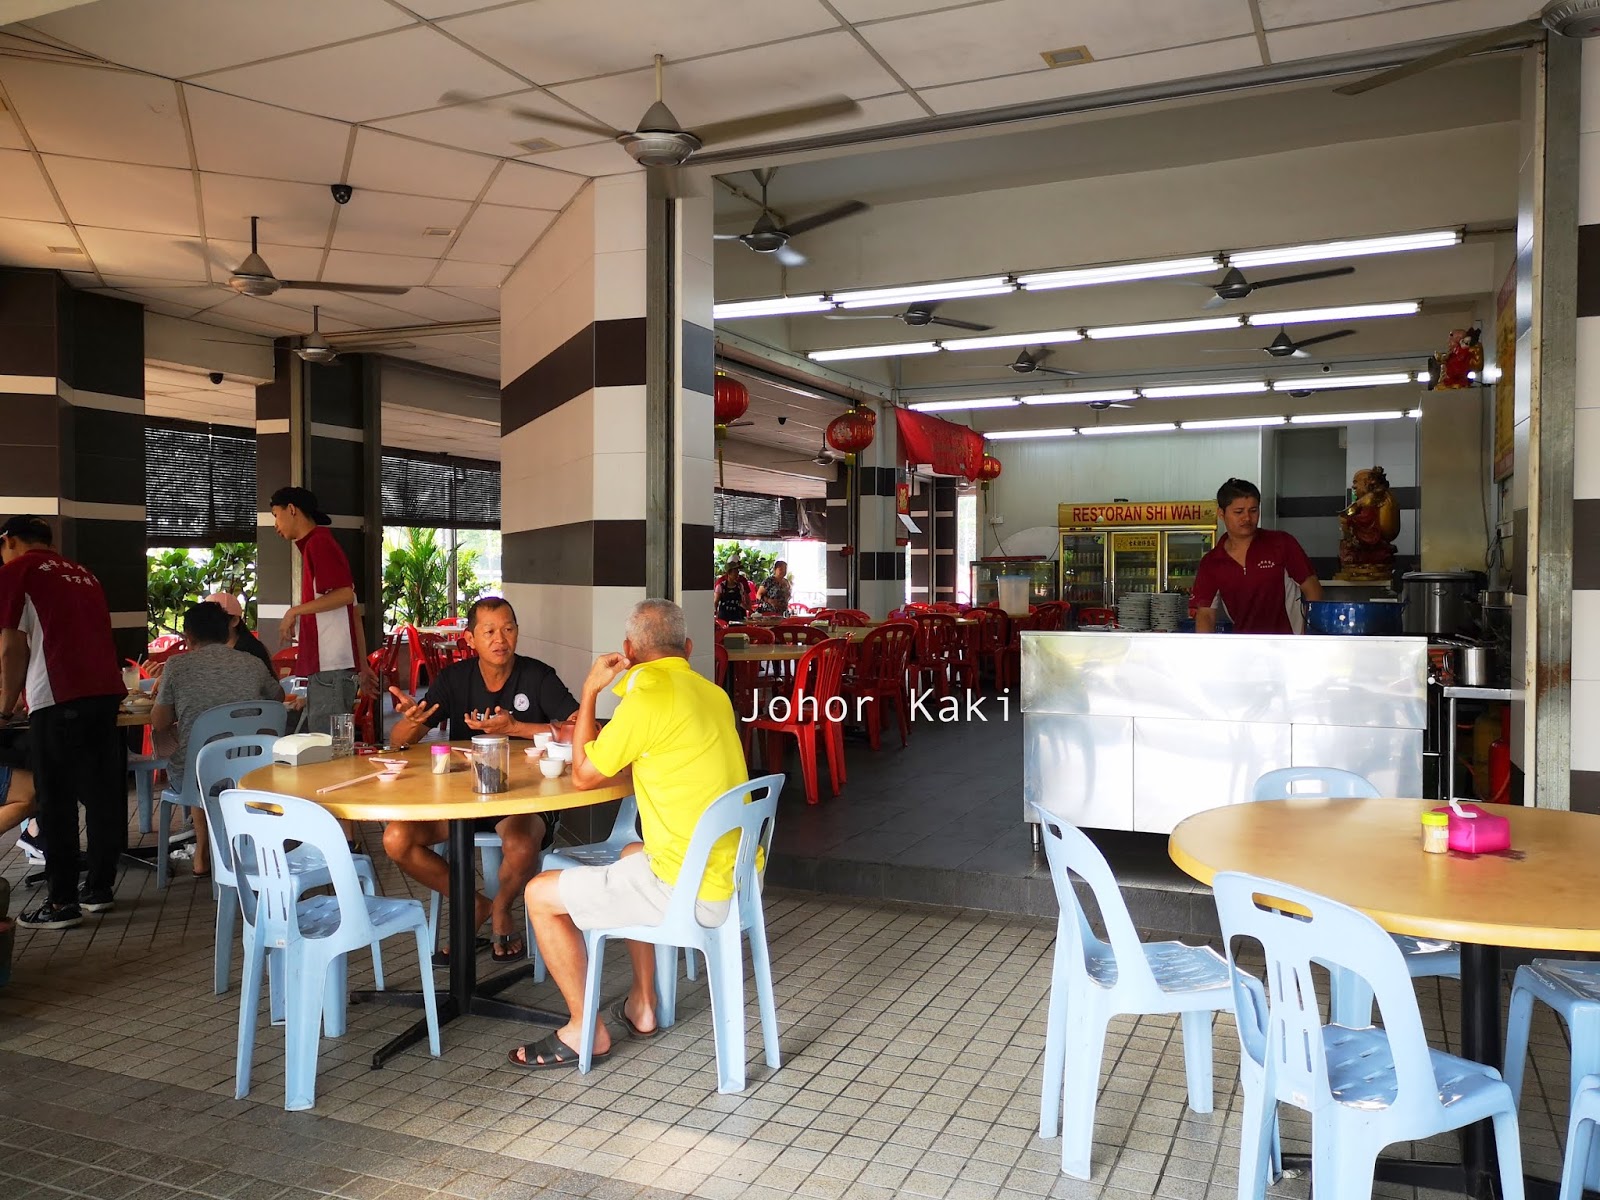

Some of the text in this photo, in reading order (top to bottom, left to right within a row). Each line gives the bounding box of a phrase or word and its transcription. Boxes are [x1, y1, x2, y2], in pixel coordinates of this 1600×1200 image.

[1073, 506, 1142, 522] RESTORAN
[1146, 506, 1167, 521] SHI
[1171, 505, 1201, 520] WAH
